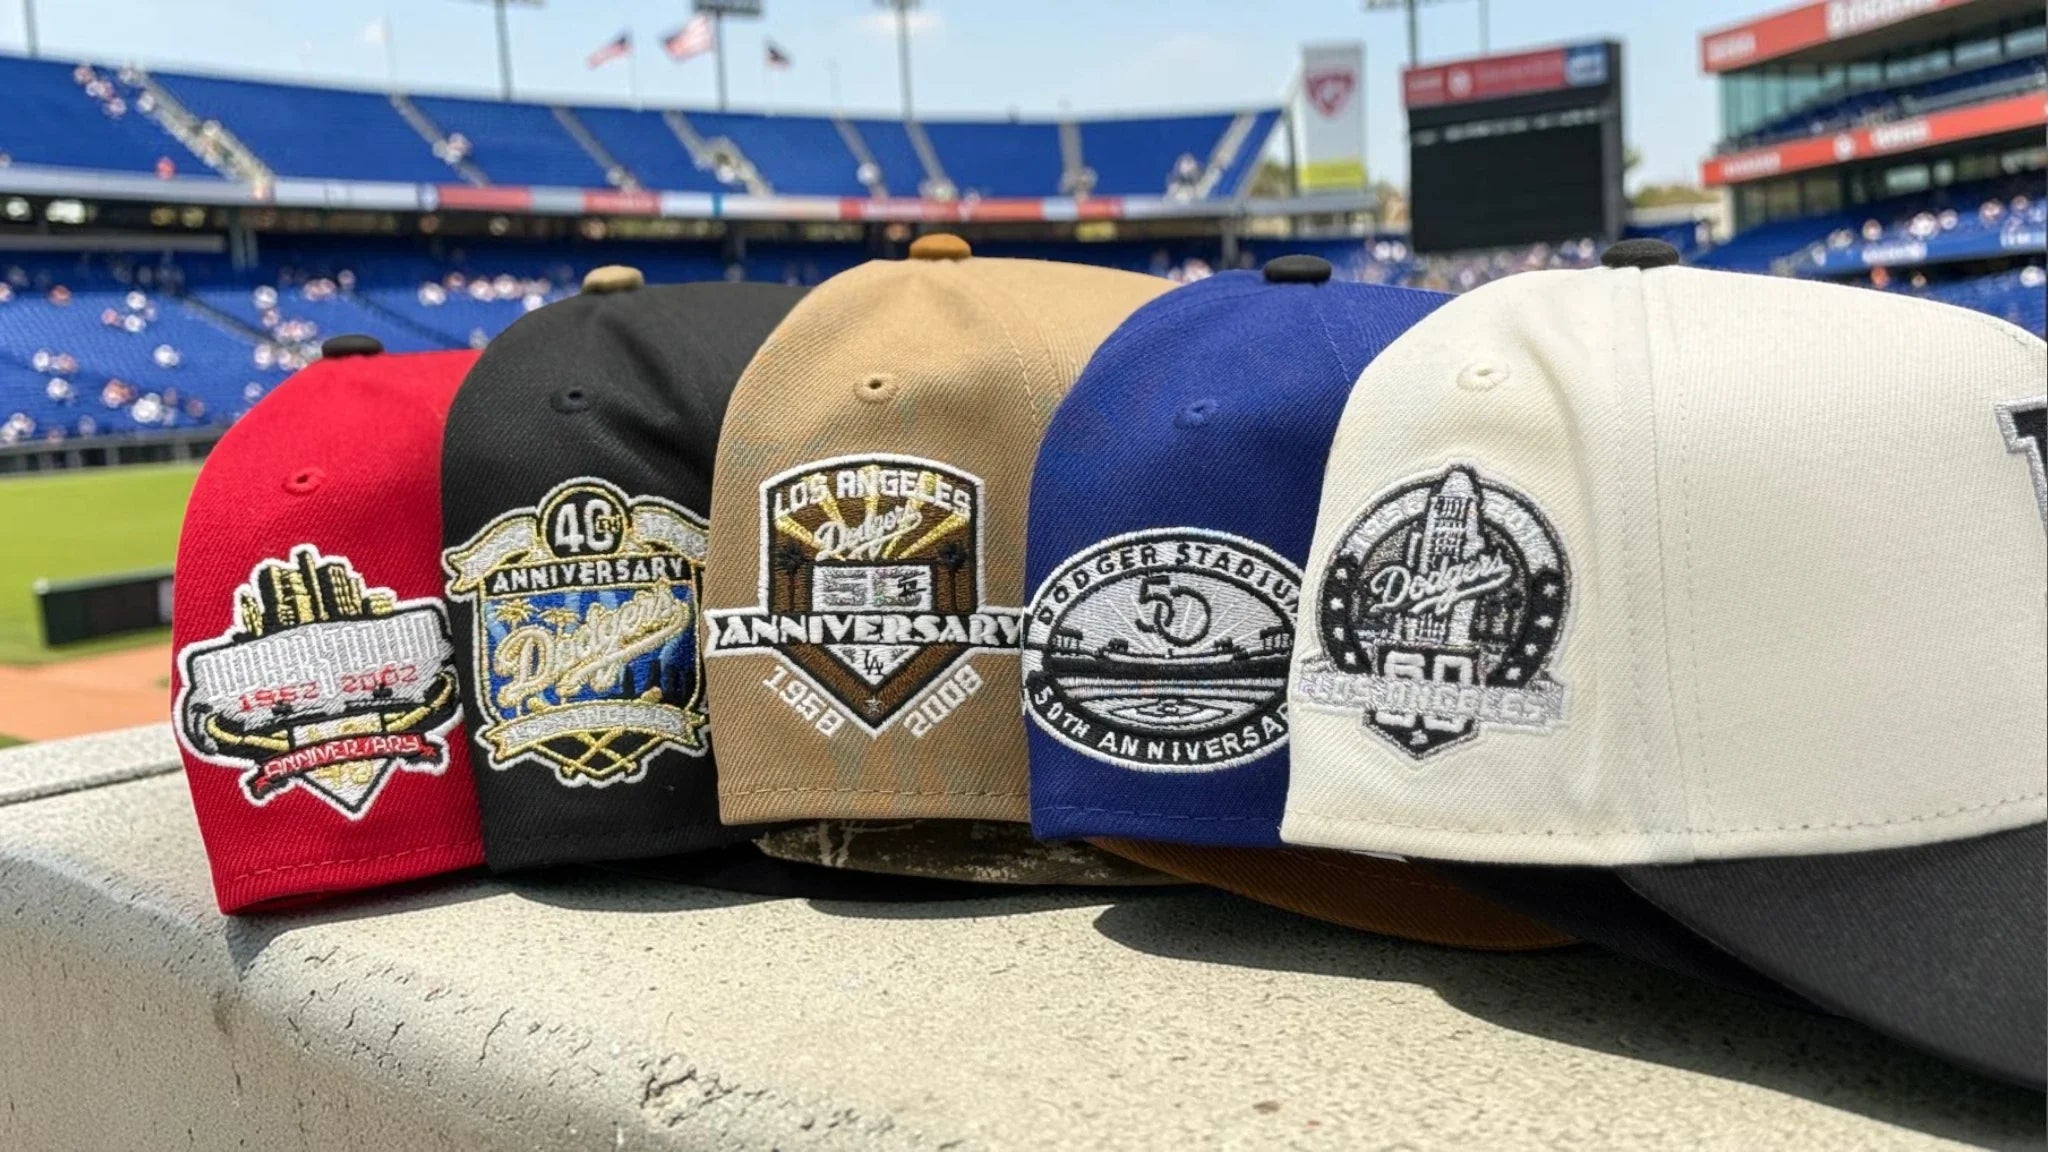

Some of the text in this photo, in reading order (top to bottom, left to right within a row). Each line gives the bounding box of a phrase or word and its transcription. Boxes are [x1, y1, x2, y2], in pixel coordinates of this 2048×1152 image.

[775, 468, 973, 518] LOS ANGELES
[813, 506, 922, 561] Dodgers
[493, 556, 683, 593] ANNIVERSARY
[1037, 544, 1157, 625] DODGER
[1369, 549, 1512, 616] Dodgers
[719, 613, 1022, 646] ANNIVERSARY
[1135, 575, 1212, 647] 50
[494, 580, 690, 707] Dodgers
[902, 665, 985, 739] 2008
[1034, 685, 1092, 739] 50TH
